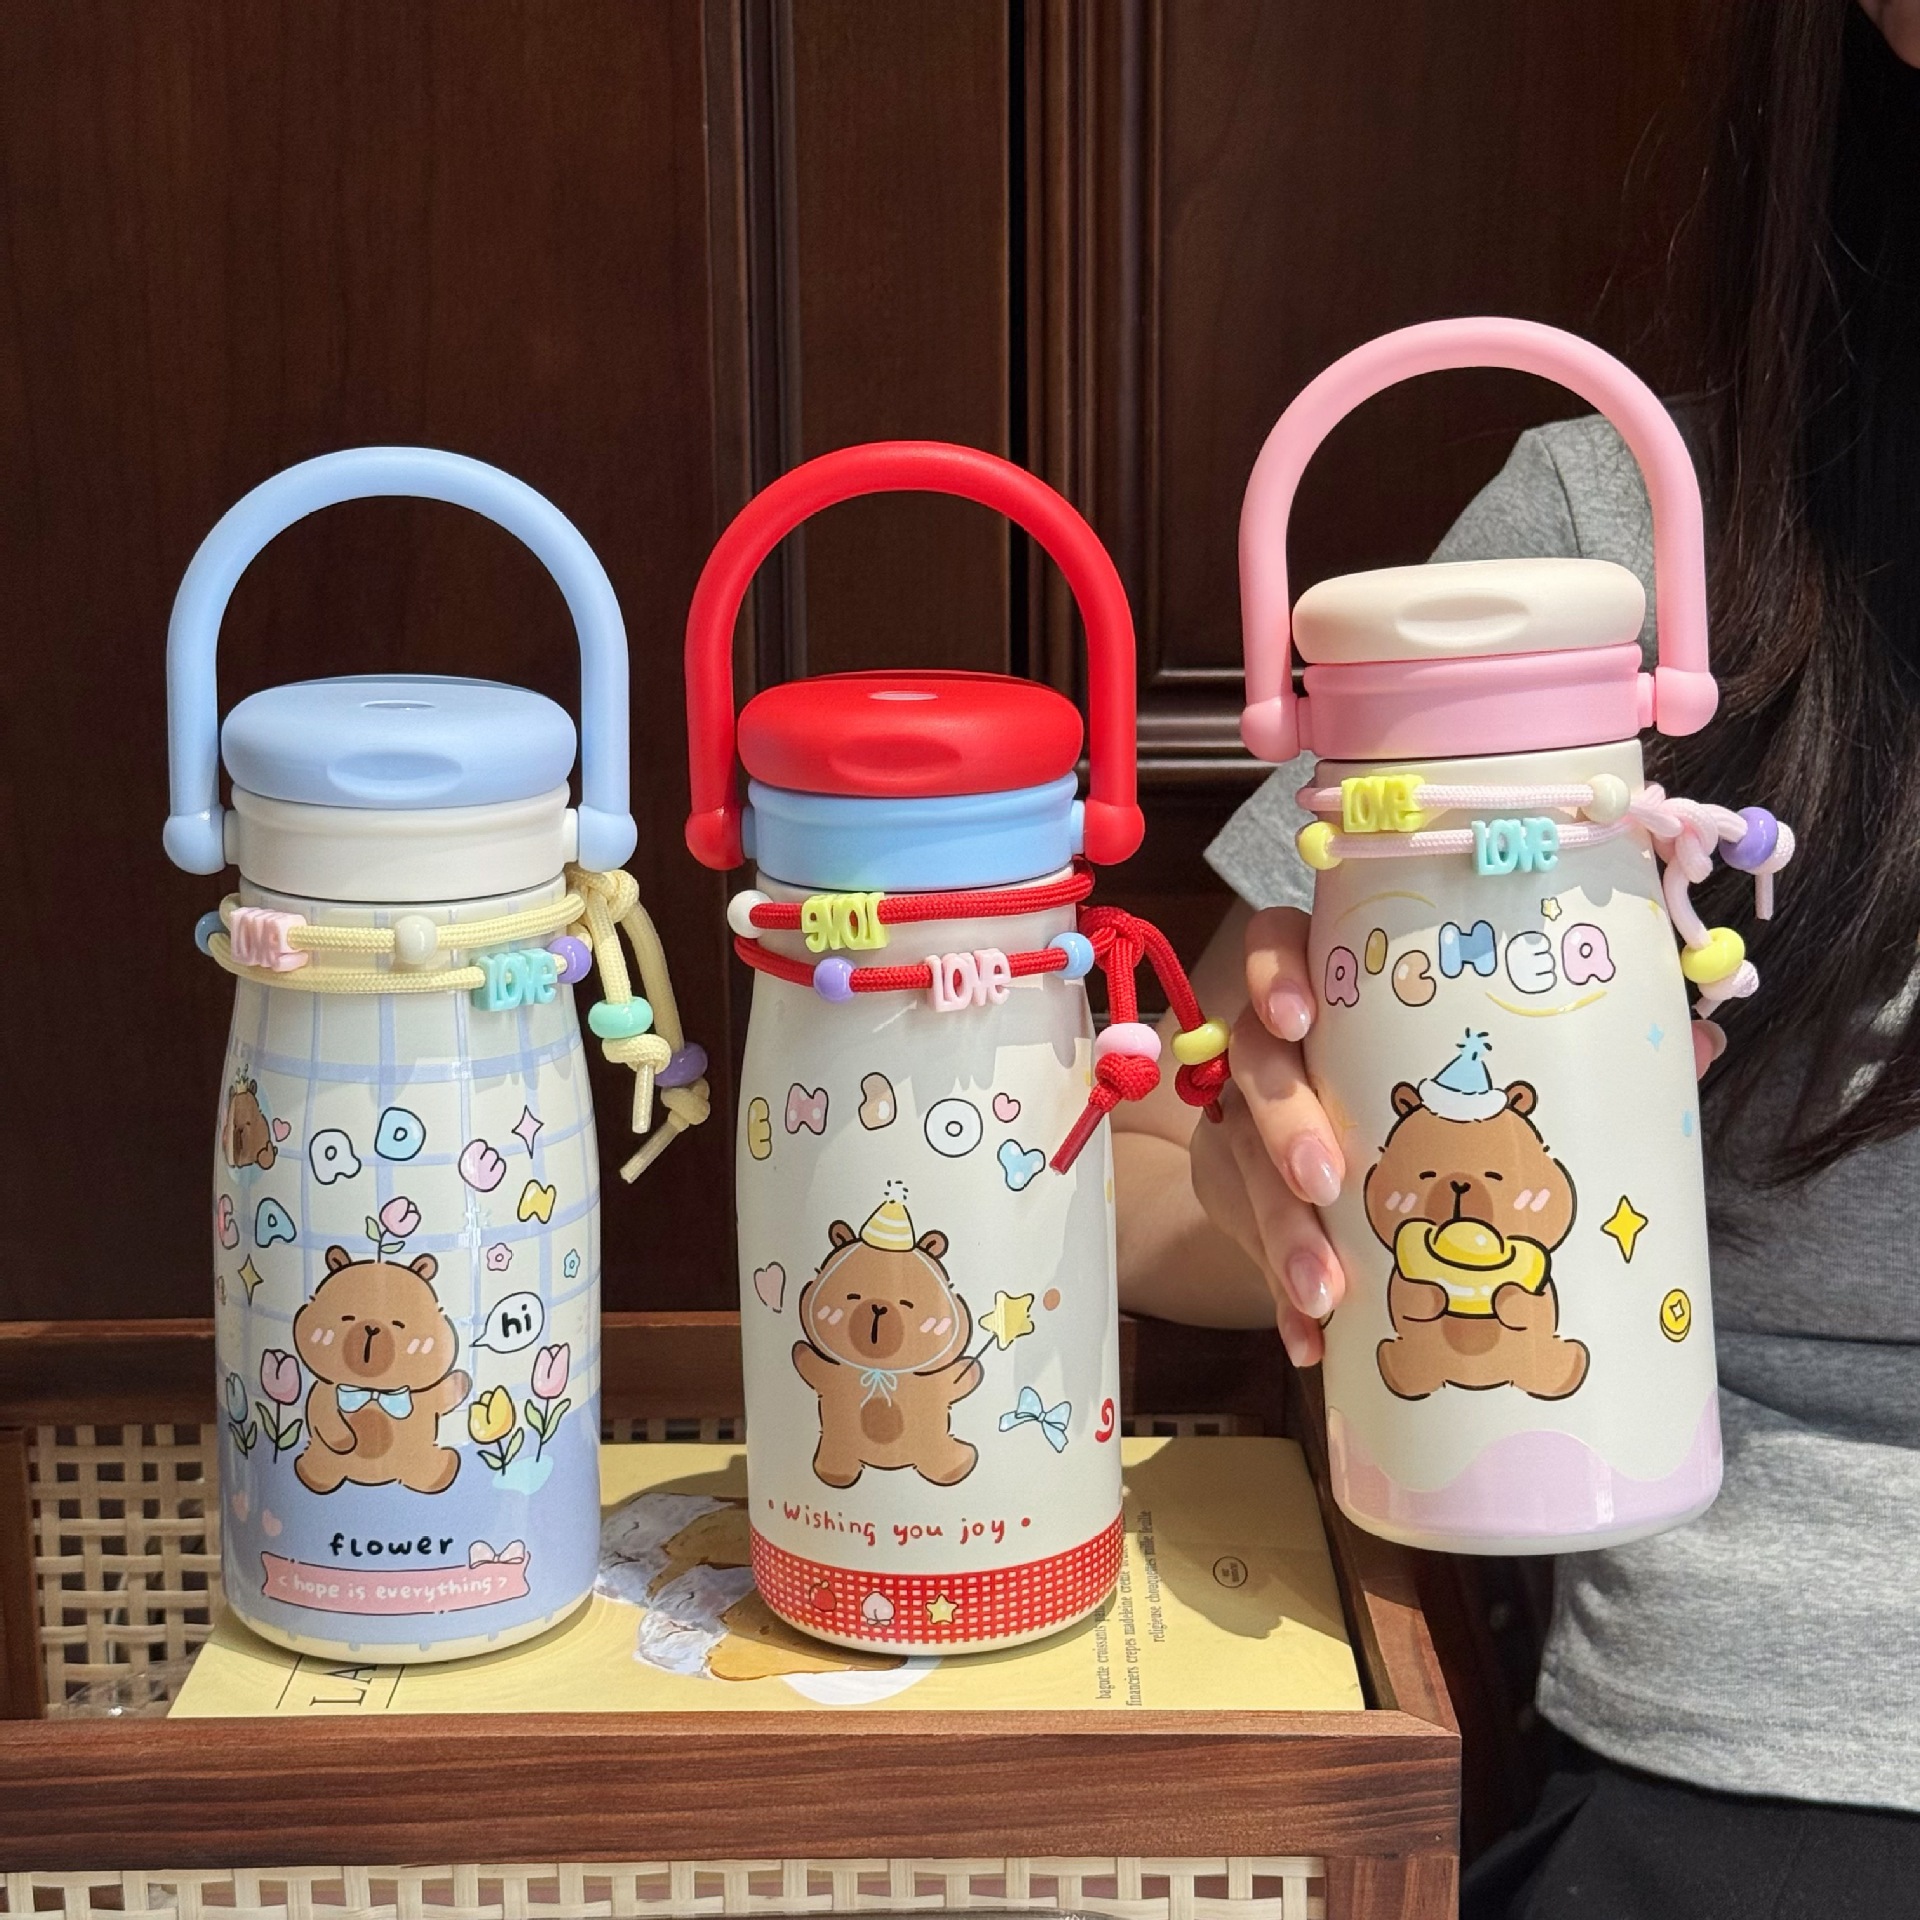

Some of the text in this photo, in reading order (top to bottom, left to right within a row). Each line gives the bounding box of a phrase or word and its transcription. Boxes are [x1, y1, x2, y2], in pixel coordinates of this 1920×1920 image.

[747, 1072, 1046, 1191] ENJOY
[502, 1304, 531, 1338] hi
[329, 1533, 454, 1557] flower
[893, 1523, 943, 1546] you
[960, 1518, 1004, 1544] joy
[347, 1583, 366, 1599] is
